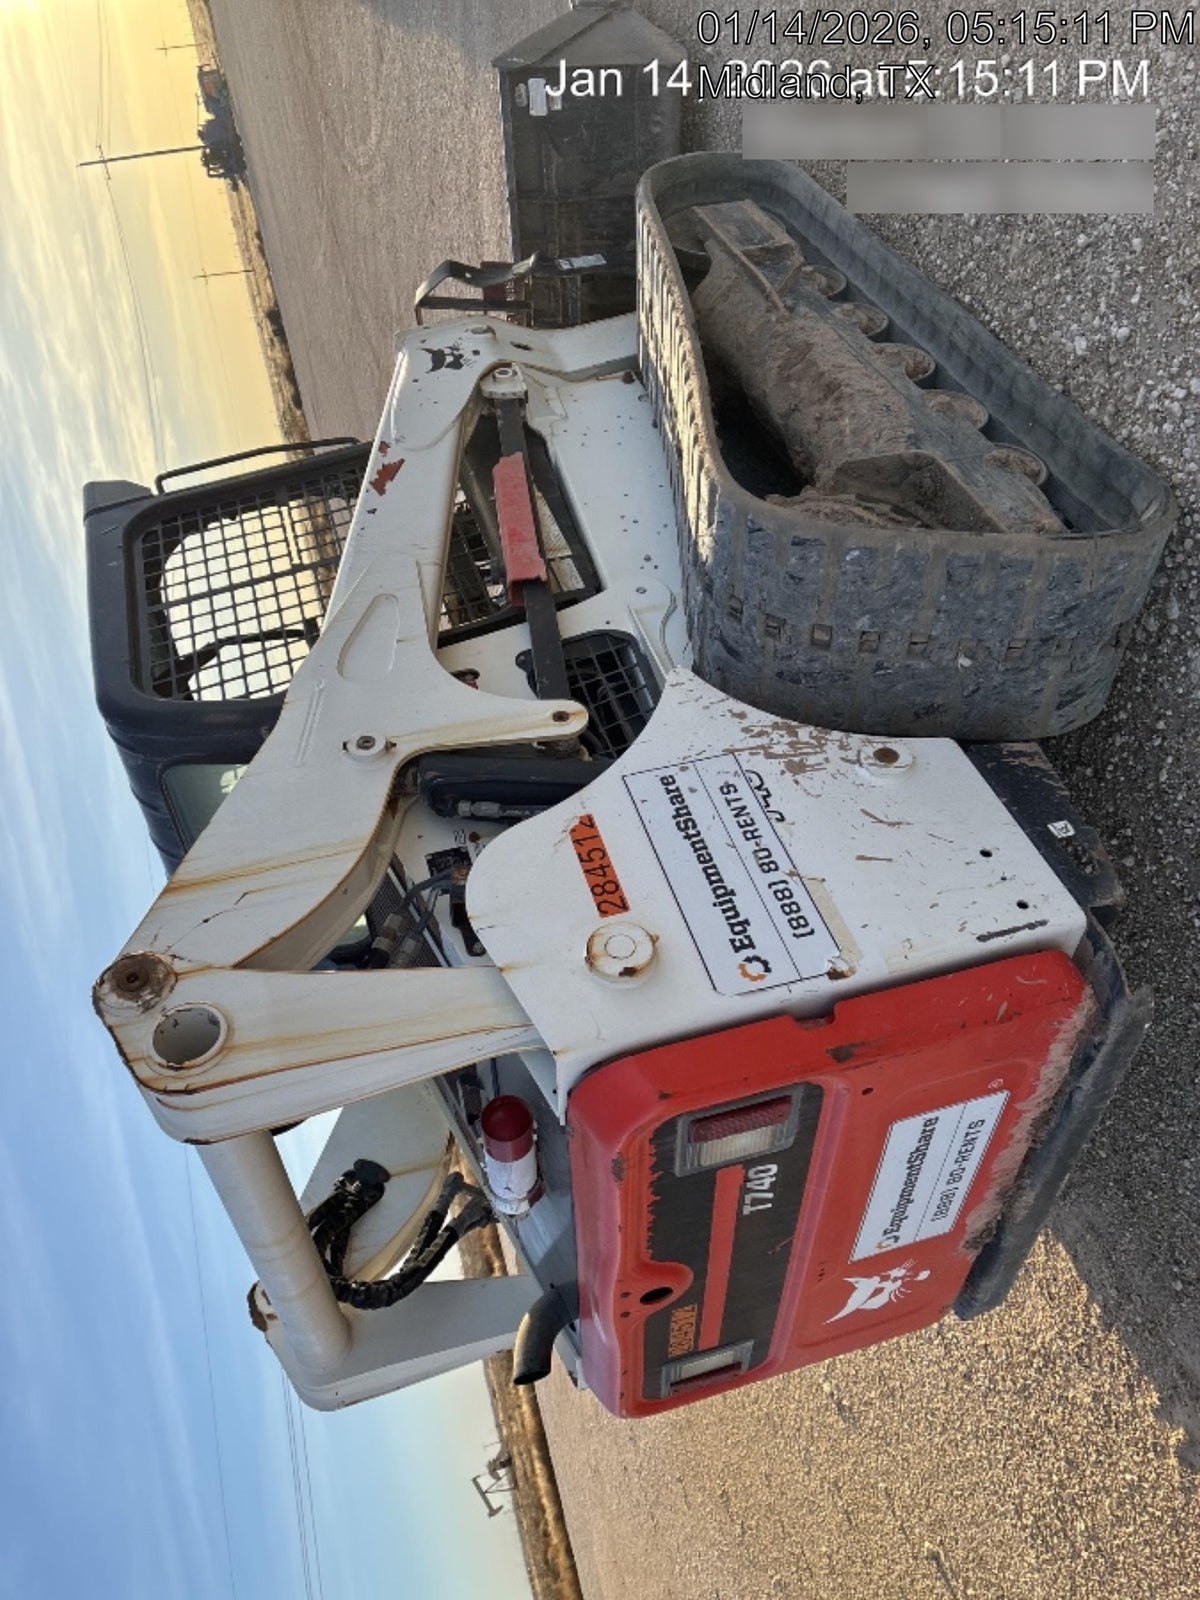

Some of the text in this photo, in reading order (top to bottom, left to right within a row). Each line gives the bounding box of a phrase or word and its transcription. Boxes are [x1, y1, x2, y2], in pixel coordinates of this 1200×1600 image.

[571, 815, 629, 915] 284512
[659, 774, 756, 953] EquipmentShare
[719, 780, 779, 875] 80-RENTS
[767, 879, 815, 939] (888)
[743, 1163, 779, 1215] T740
[882, 1116, 940, 1237] EquipmentShare
[945, 1118, 985, 1187] 80-RENTS
